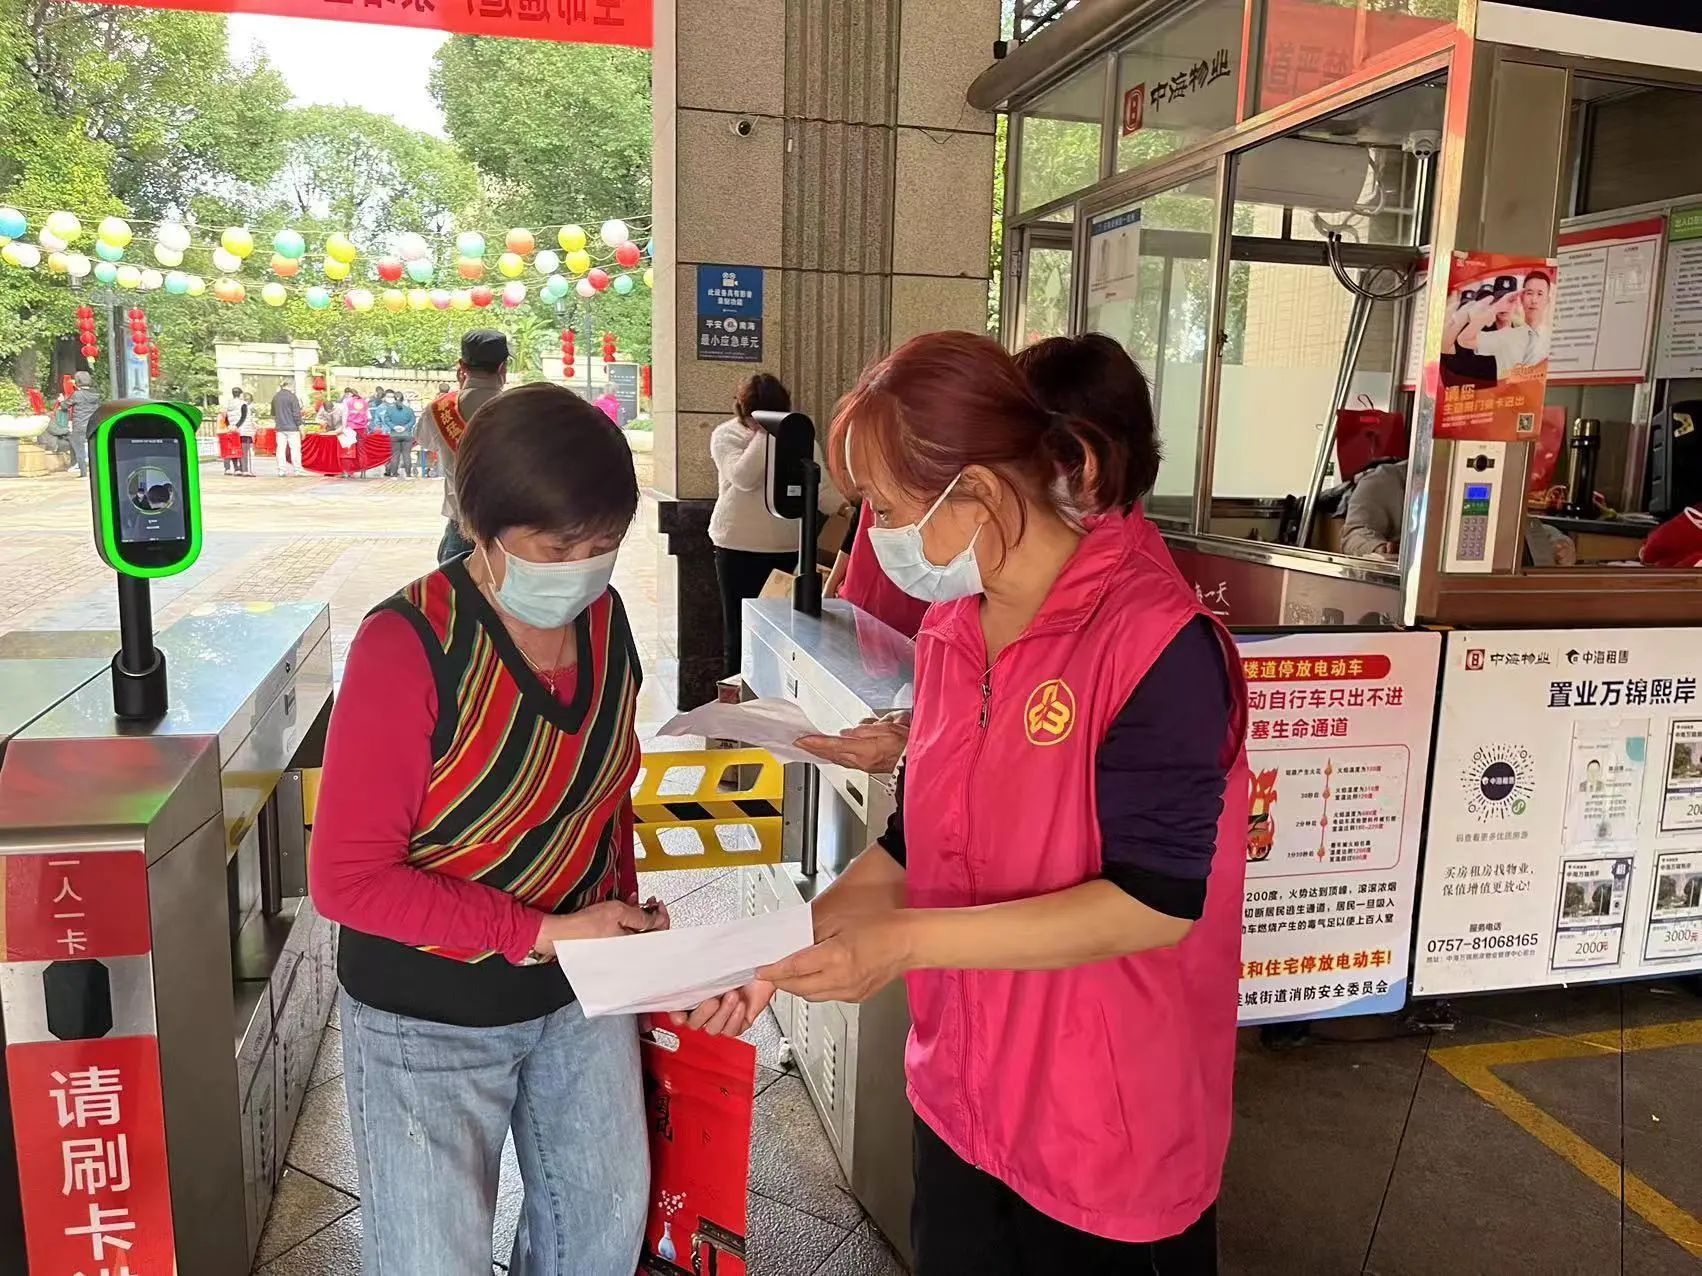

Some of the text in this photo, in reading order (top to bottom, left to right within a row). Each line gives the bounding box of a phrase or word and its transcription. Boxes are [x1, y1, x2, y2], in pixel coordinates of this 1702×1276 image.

[1150, 49, 1231, 112] 中海物业
[706, 319, 722, 329] 平安
[700, 333, 760, 348] 最小应急单元
[1489, 649, 1630, 666] 中海物业 中海租售
[1249, 685, 1404, 711] 动自行车只出不进
[1547, 676, 1697, 708] 置业万锦熙岸
[1247, 716, 1349, 741] 塞生命通道
[1687, 803, 1702, 817] 20
[48, 860, 88, 955] 一人一卡
[1469, 922, 1502, 933] 服务电话
[1427, 932, 1539, 952] 0757-81068165
[49, 1066, 138, 1276] 请刷卡
